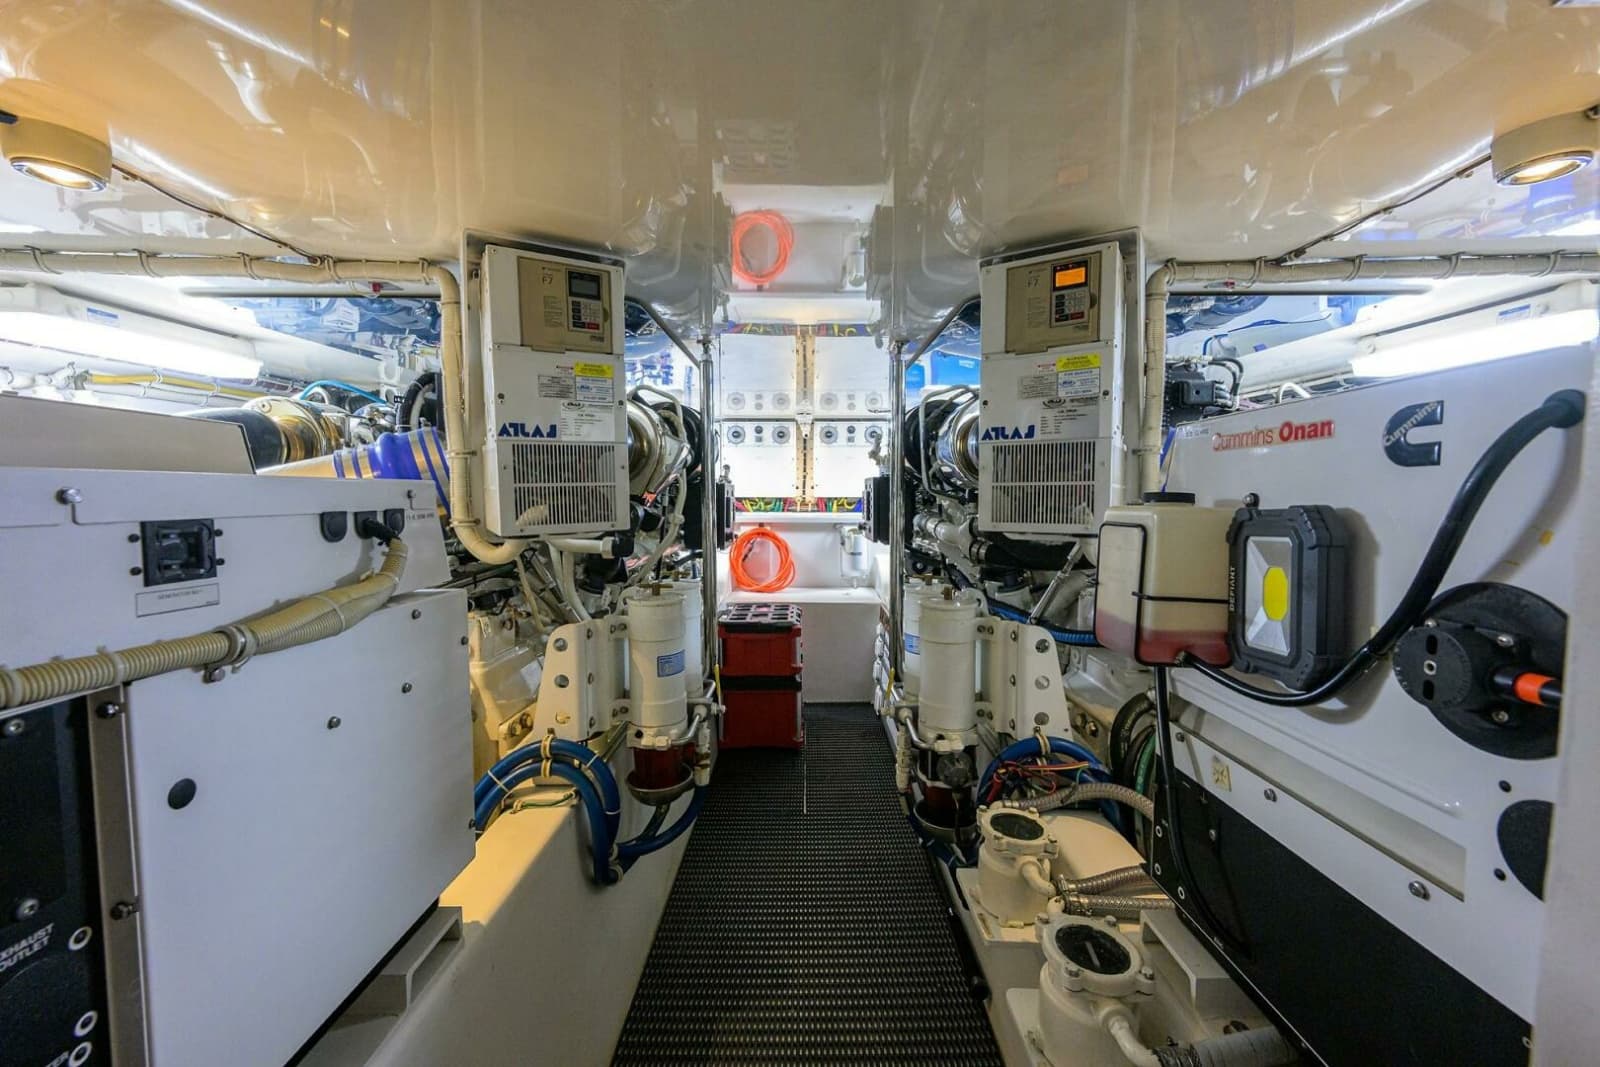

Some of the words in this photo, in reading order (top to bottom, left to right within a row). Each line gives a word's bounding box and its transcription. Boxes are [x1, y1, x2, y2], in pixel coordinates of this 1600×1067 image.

[498, 422, 557, 438] ATLAS
[981, 425, 1035, 441] ATLAS
[1212, 428, 1273, 452] Cummins
[1279, 420, 1335, 442] Onan
[1383, 402, 1437, 447] Cummins
